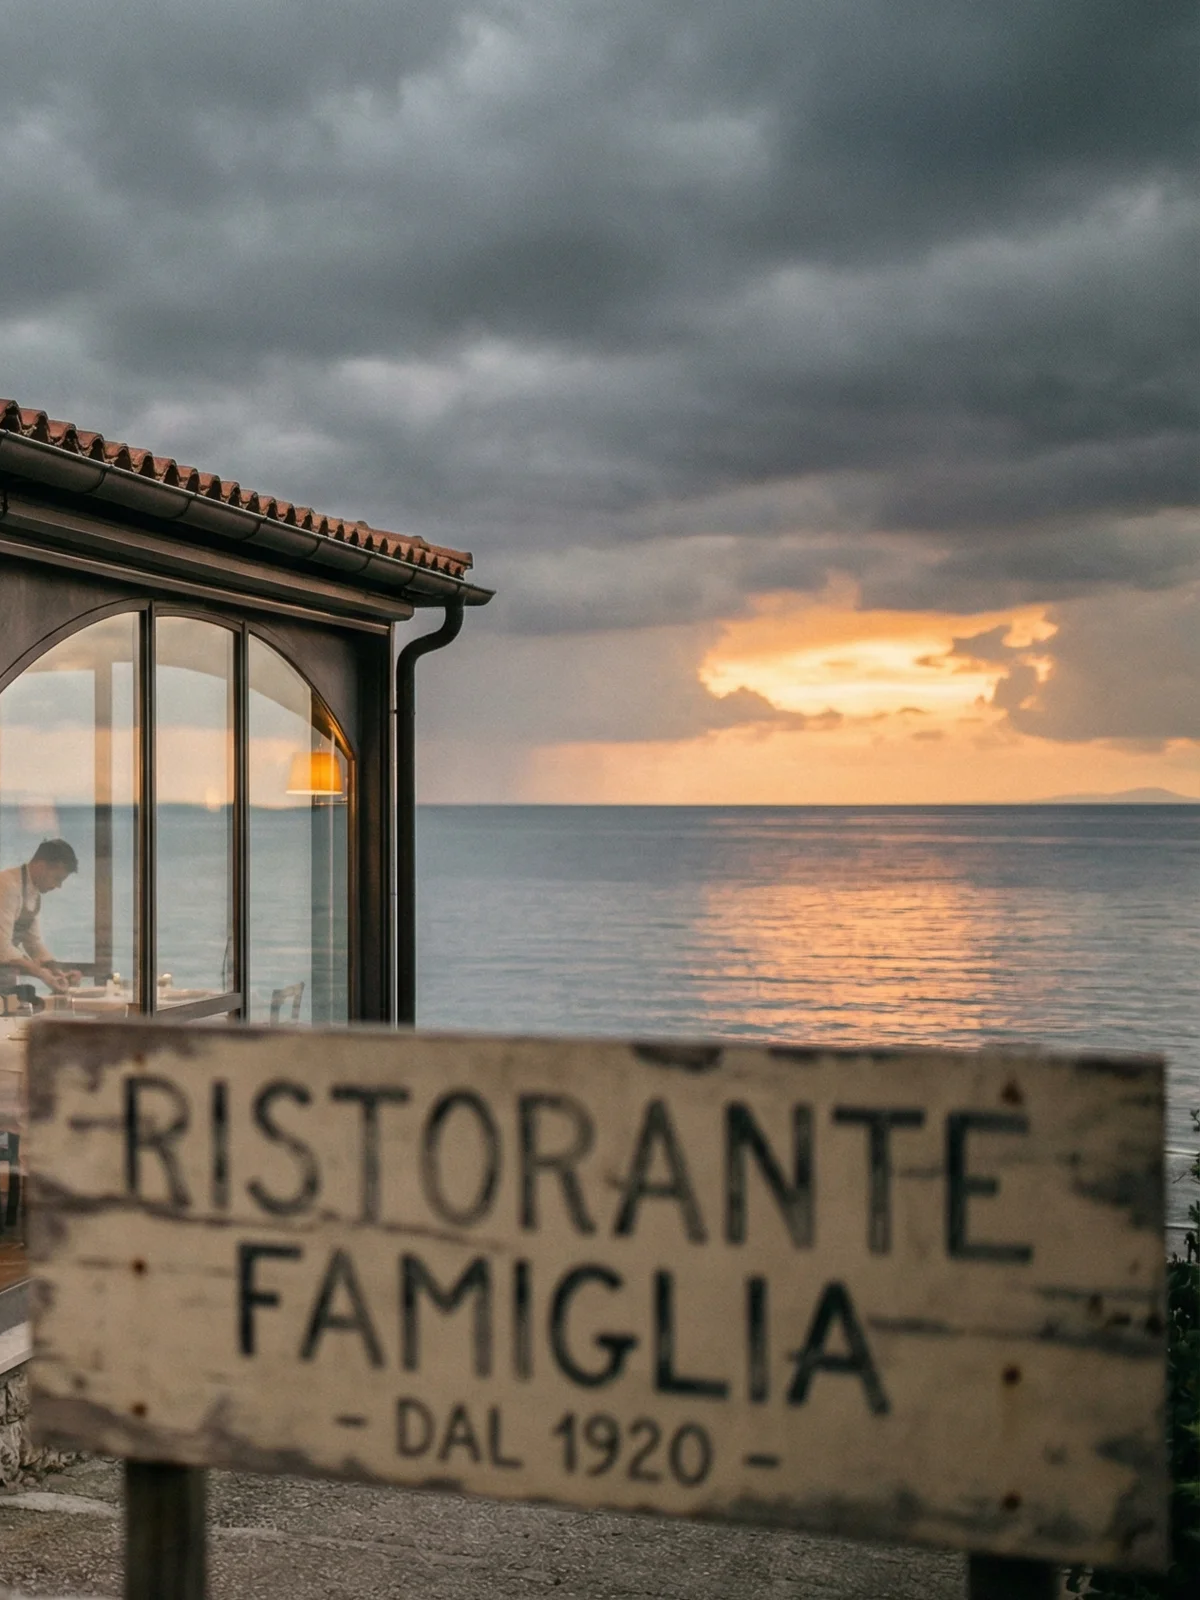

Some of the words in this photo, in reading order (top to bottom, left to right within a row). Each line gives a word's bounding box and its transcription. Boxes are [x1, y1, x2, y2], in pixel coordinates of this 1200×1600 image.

[122, 1076, 1035, 1263] RISTORANTE
[237, 1242, 890, 1415] FAMIGLIA
[397, 1398, 522, 1469] DAL
[553, 1413, 714, 1487] 1920
